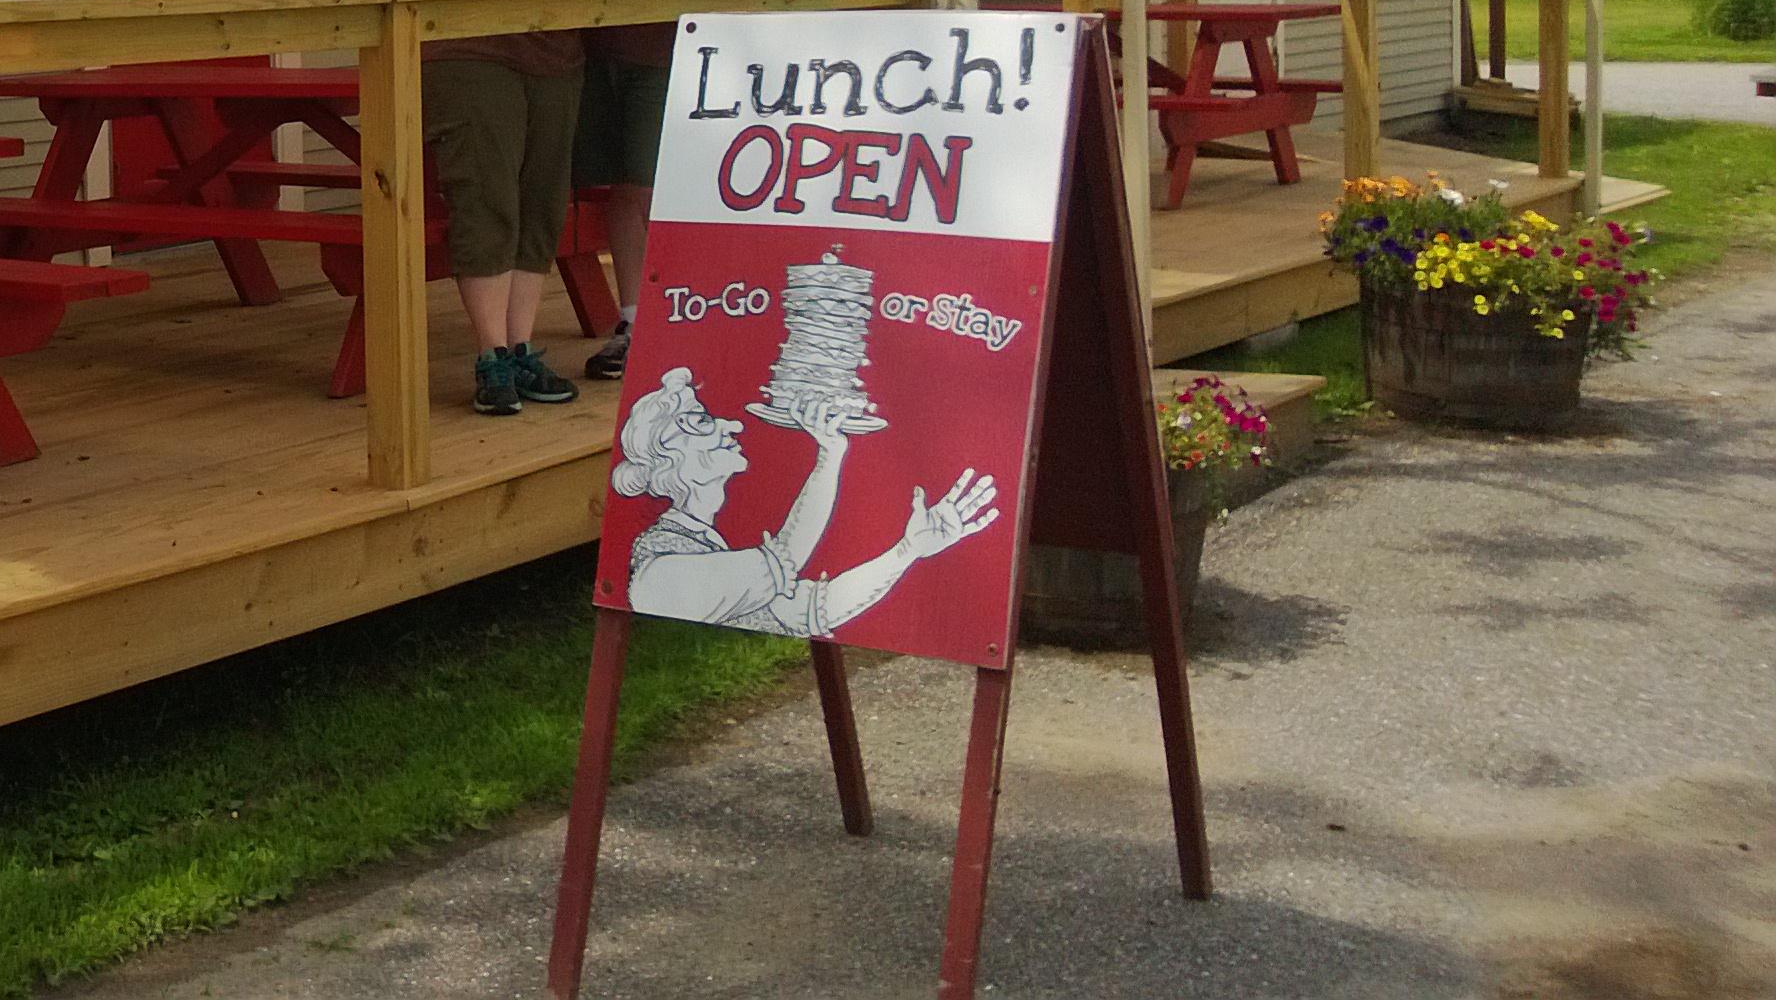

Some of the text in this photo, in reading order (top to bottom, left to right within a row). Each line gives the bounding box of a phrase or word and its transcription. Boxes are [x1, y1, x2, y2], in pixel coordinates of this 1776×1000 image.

[688, 28, 1036, 120] Lunch!
[718, 122, 972, 224] OPEN
[665, 282, 770, 322] To-Go
[881, 293, 927, 320] or
